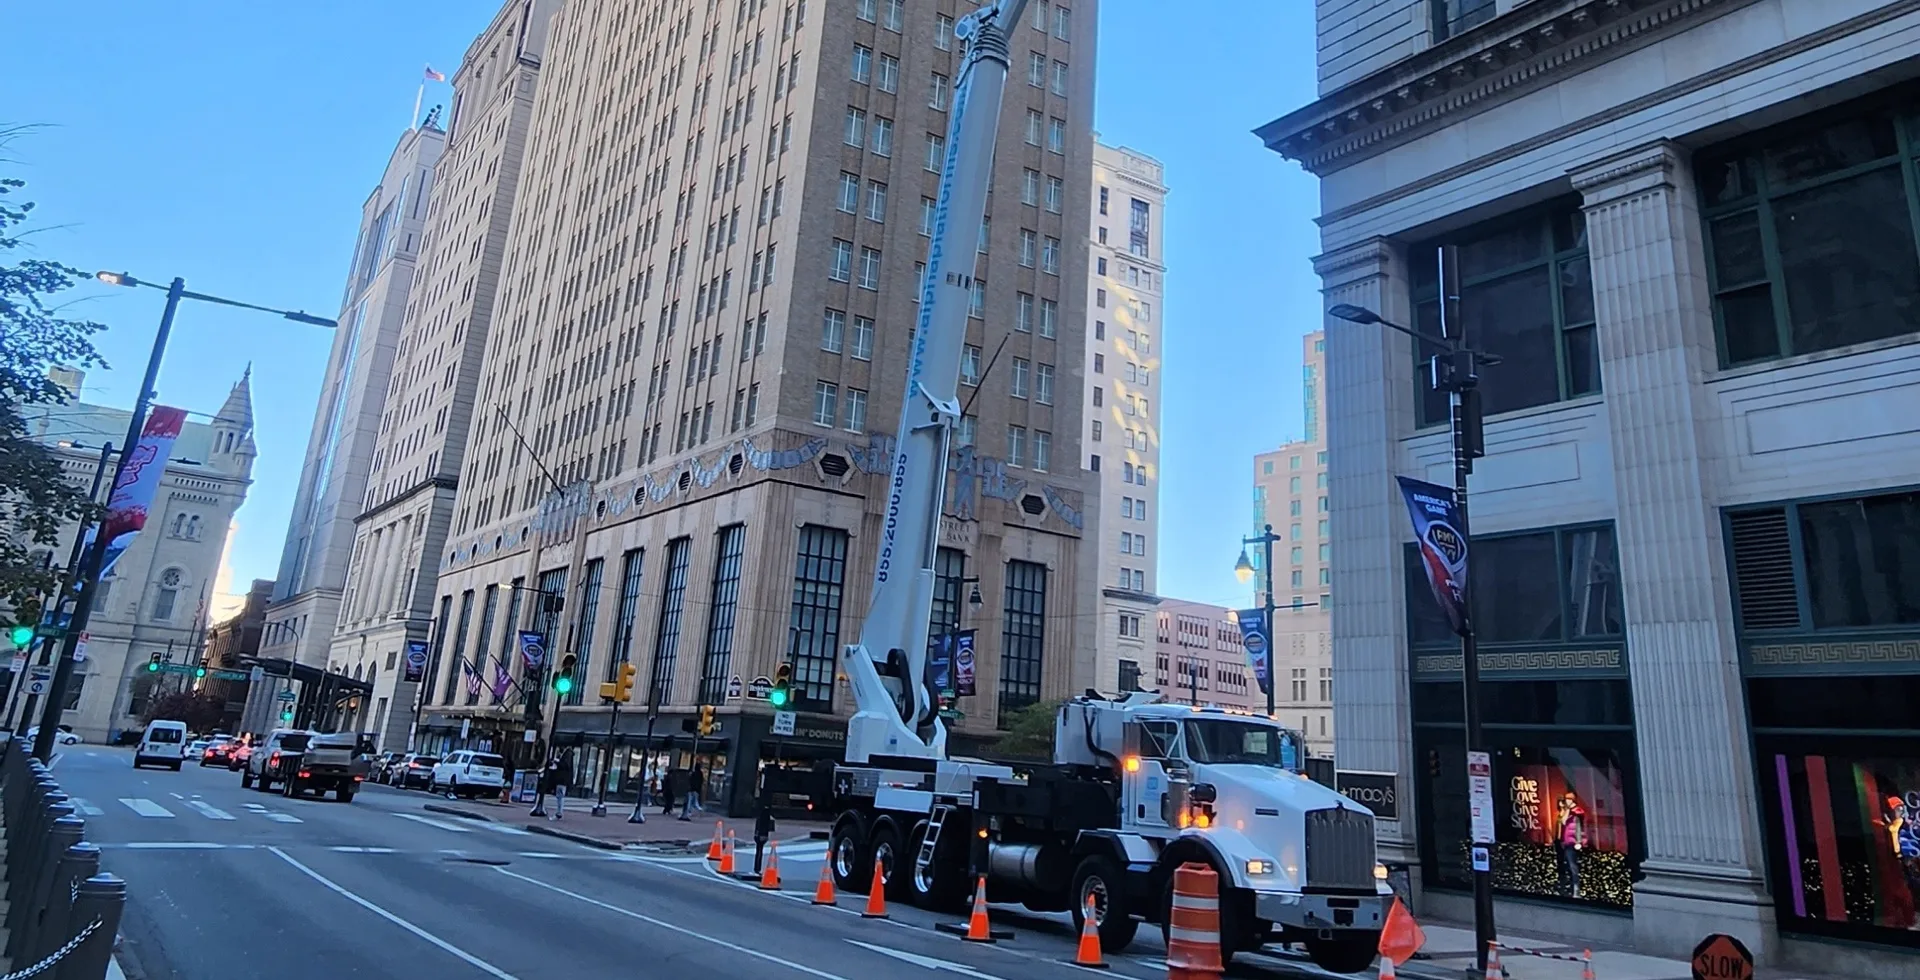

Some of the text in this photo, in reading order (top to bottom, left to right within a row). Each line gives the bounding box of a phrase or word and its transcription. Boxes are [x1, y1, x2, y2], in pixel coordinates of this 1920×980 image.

[1413, 493, 1452, 509] AMERICA'S
[878, 453, 907, 582] 855.2000.855
[808, 729, 845, 741] DONUTS
[1511, 775, 1538, 792] Give
[1349, 786, 1395, 806] macy's
[1512, 801, 1539, 817] Give
[1700, 954, 1744, 979] SLOW
